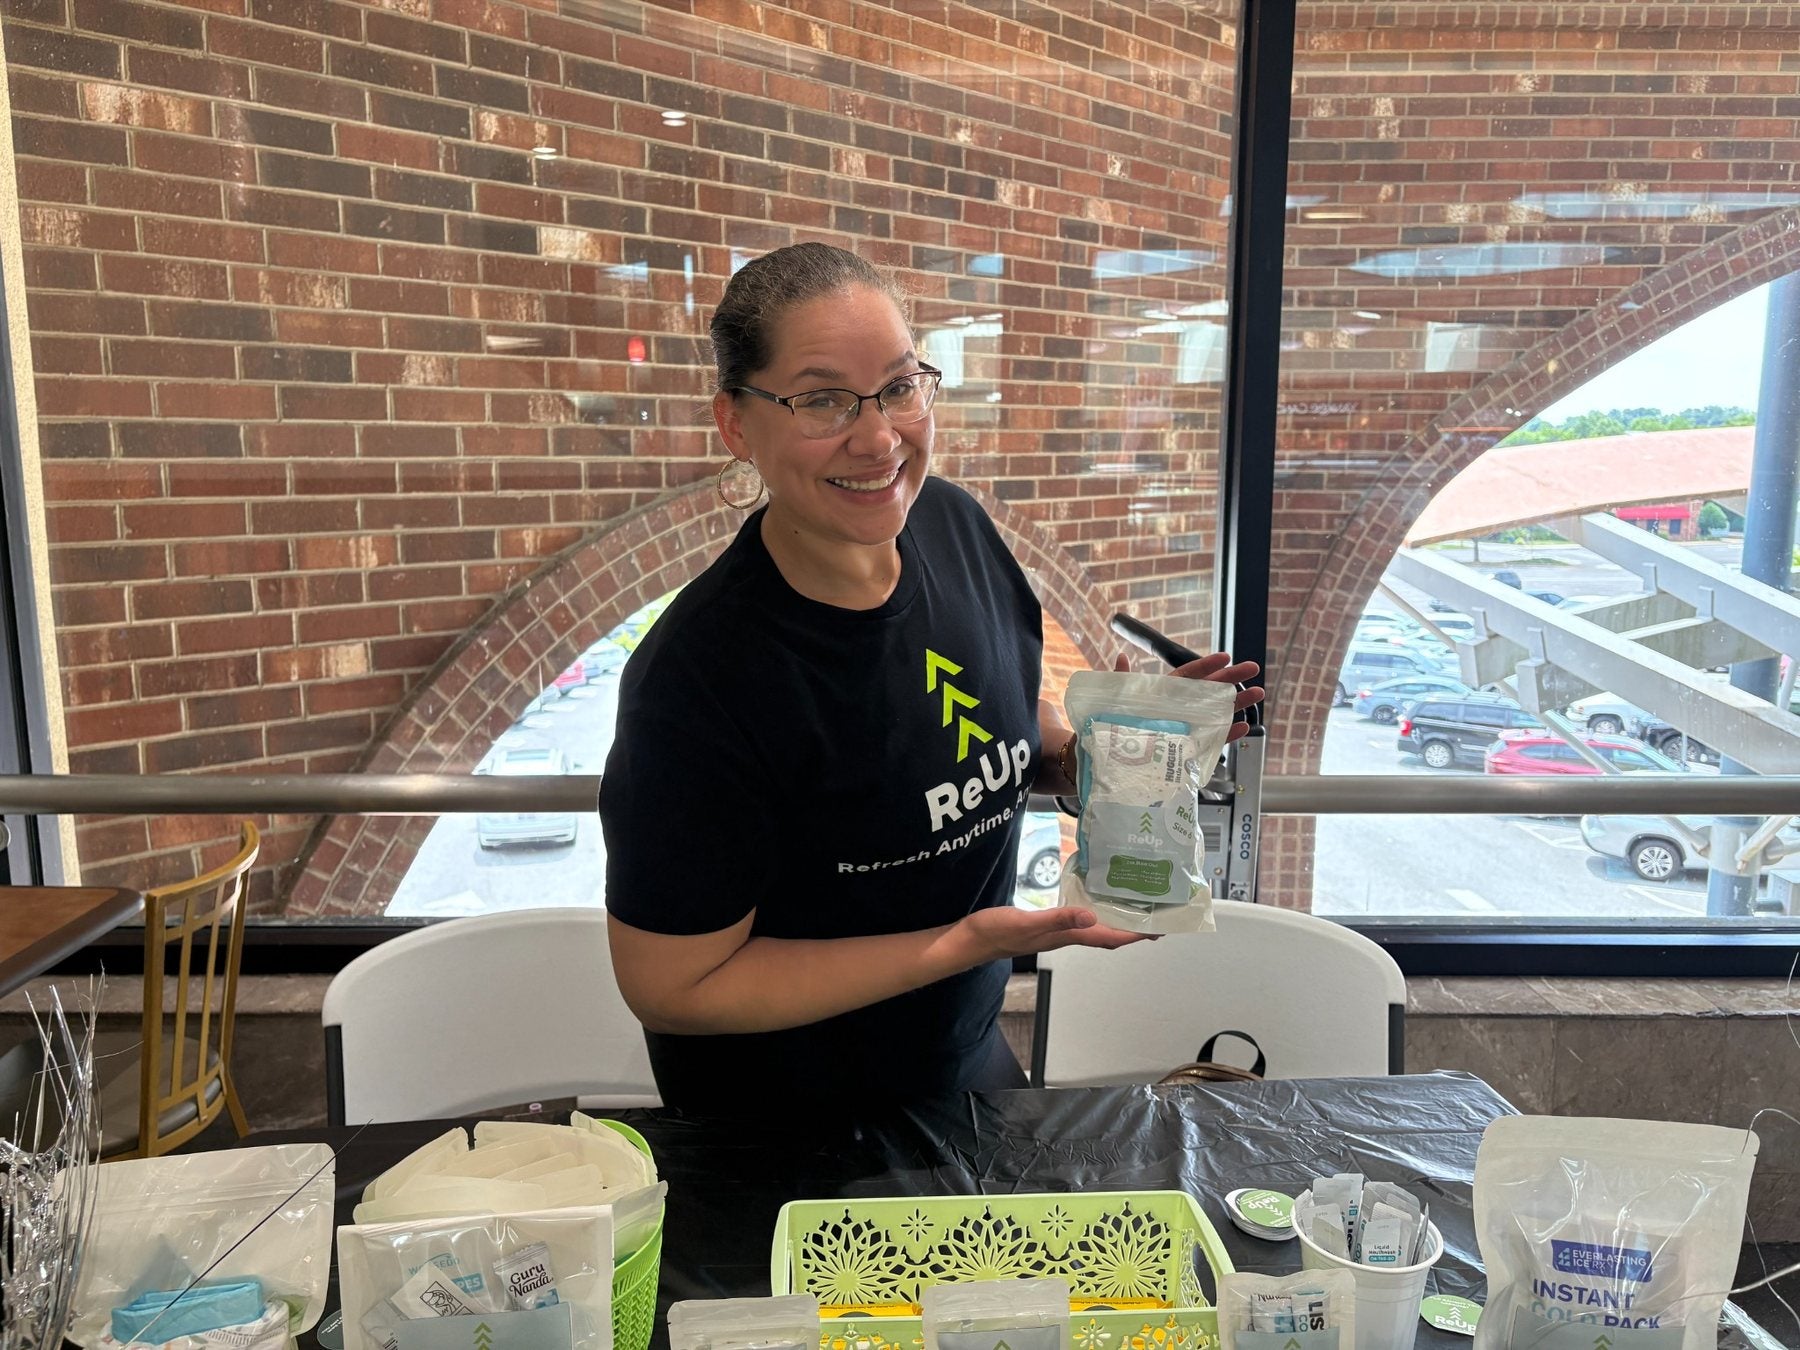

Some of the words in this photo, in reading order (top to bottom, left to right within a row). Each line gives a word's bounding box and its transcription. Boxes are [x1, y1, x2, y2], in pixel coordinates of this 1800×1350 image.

[1165, 740, 1177, 783] HUGGIES
[924, 738, 1031, 832] ReUp
[838, 850, 931, 873] Refresh
[936, 806, 1014, 856] Anytime,
[1127, 833, 1164, 848] ReUp
[1173, 822, 1187, 837] Size
[1187, 831, 1193, 840] 6
[1239, 813, 1253, 860] COSCO
[1572, 1249, 1647, 1267] EVERLASTING
[1572, 1258, 1591, 1268] ICE
[1592, 1260, 1606, 1270] RX
[509, 1270, 551, 1297] Nanda
[510, 1263, 545, 1284] Guru
[1533, 1278, 1636, 1310] INSTANT
